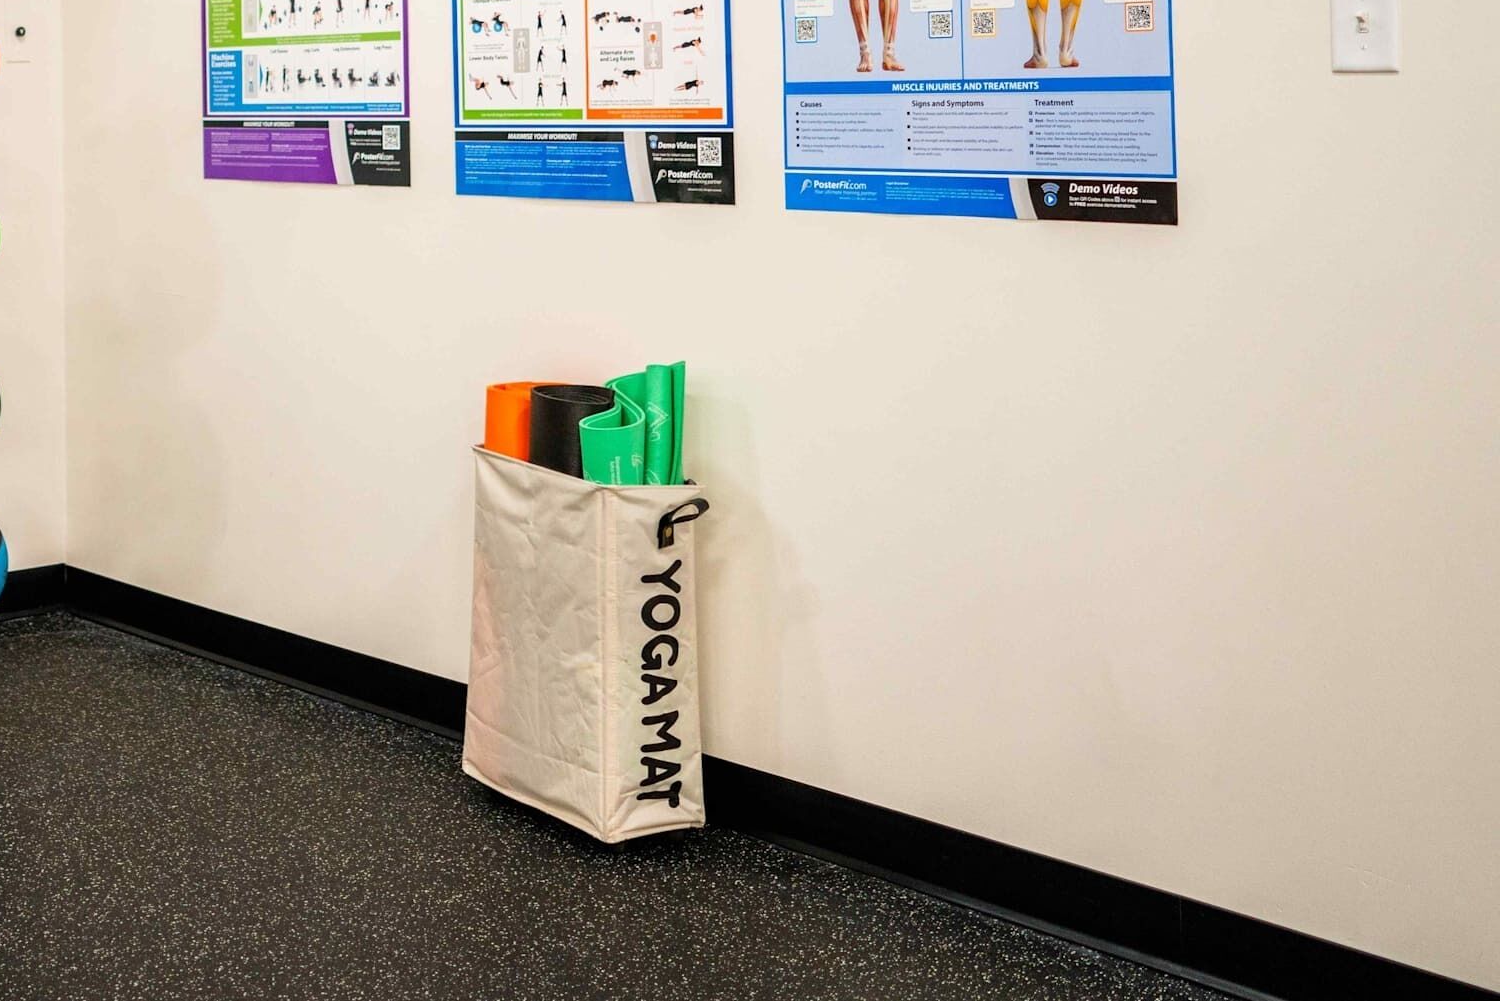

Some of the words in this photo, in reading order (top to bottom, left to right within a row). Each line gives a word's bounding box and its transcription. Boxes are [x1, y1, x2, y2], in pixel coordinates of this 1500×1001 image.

[892, 82, 924, 92] MUSCLE
[925, 82, 961, 91] INJURIES
[963, 82, 982, 91] AND
[983, 81, 1039, 90] TREATMENTS
[800, 100, 822, 108] Causes
[911, 99, 930, 108] Signs
[931, 99, 945, 107] and
[946, 99, 984, 108] Symptoms
[1034, 99, 1074, 107] Treatment
[657, 141, 676, 149] Demo
[676, 141, 697, 149] Videos
[667, 169, 713, 179] PosterFit.com
[813, 179, 867, 191] PosterFit.com
[1068, 182, 1101, 194] Demo
[1102, 183, 1139, 195] Videos
[640, 558, 682, 706] YOGA
[637, 708, 683, 809] MAT
